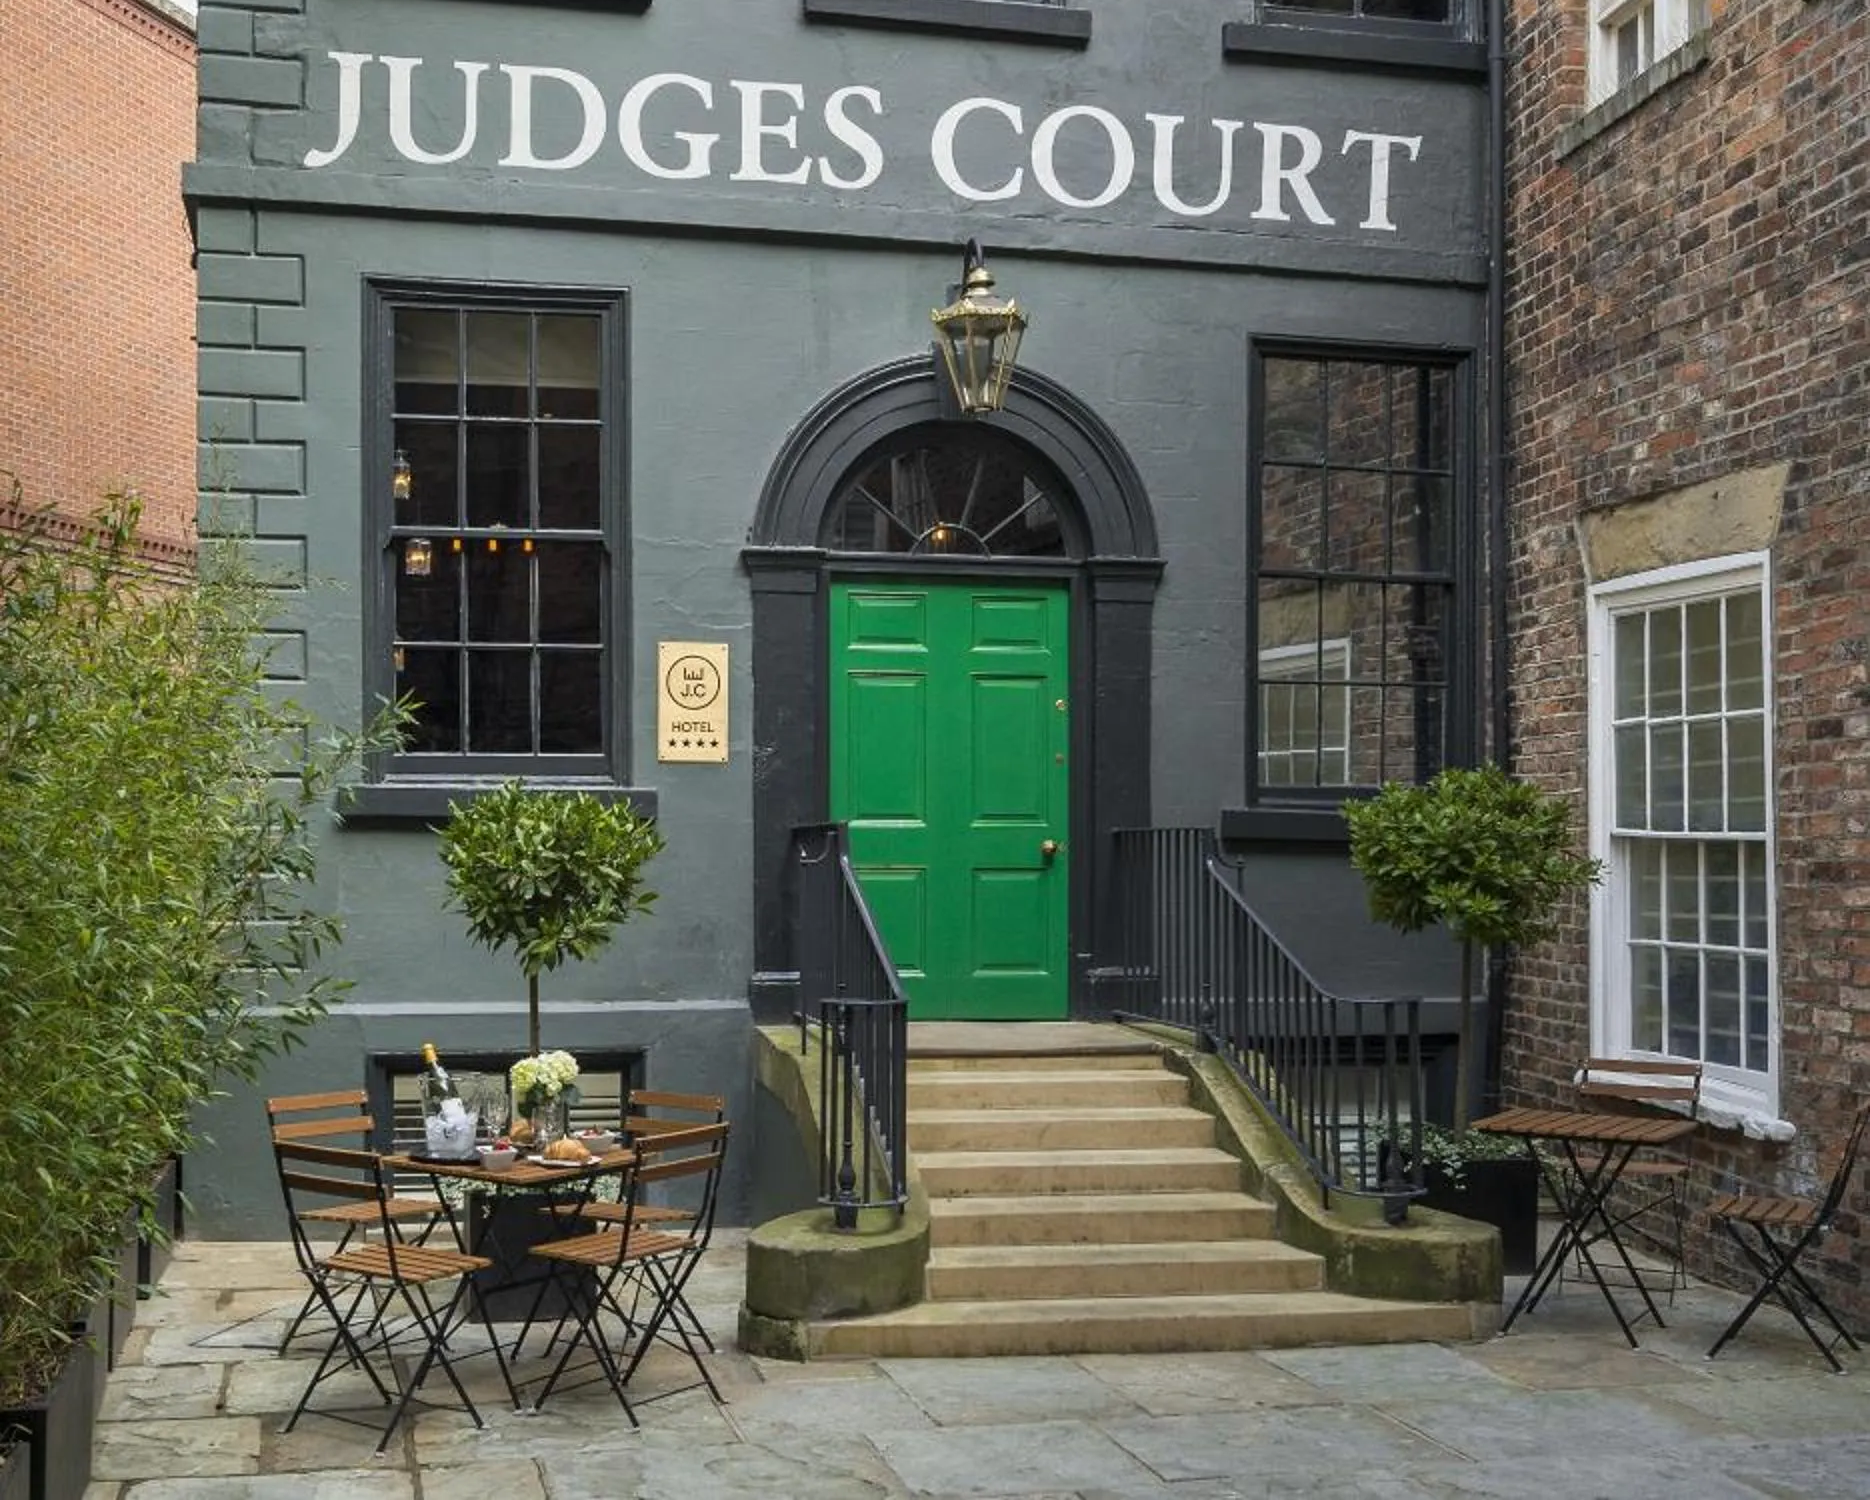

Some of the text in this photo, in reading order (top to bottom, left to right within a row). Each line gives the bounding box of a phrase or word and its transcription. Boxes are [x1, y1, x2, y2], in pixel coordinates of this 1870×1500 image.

[302, 50, 1424, 232] JUDGES COURT
[671, 721, 715, 733] HOTEL
